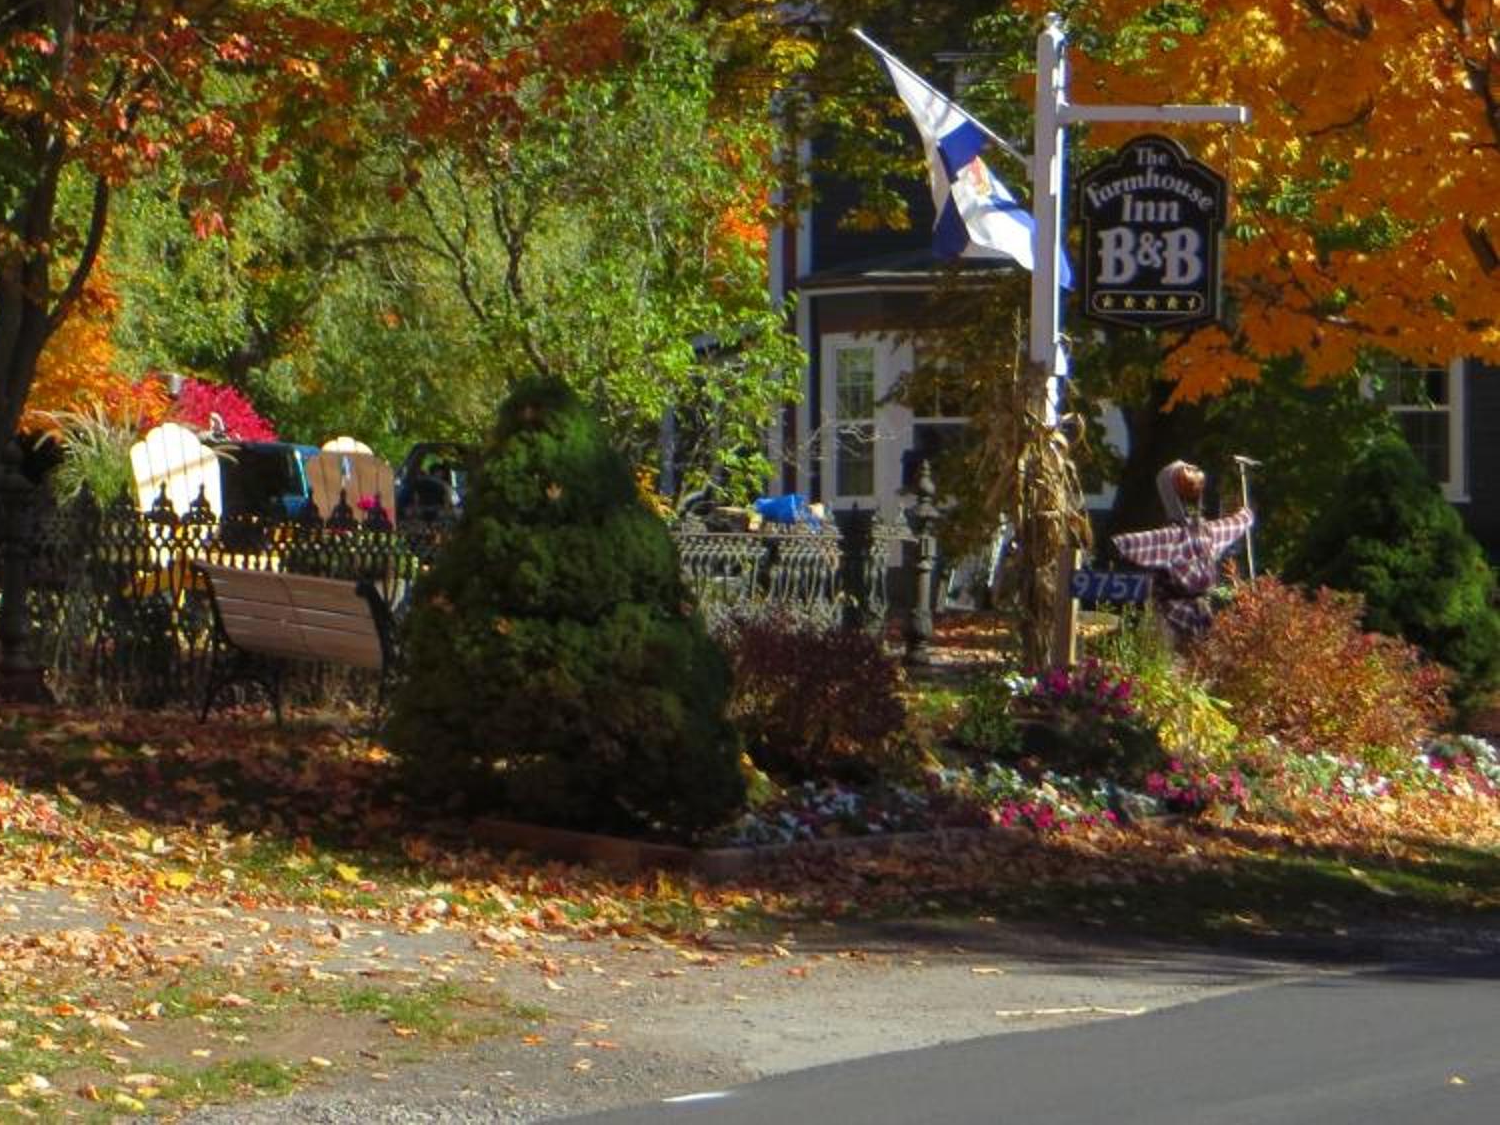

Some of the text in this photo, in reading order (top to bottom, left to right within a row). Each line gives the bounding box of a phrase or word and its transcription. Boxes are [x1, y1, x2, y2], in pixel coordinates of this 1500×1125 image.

[1135, 148, 1169, 166] The
[1086, 167, 1213, 210] Farmhouse
[1122, 194, 1180, 222] Inn
[1097, 227, 1202, 284] B&B
[1074, 572, 1145, 598] 9757
